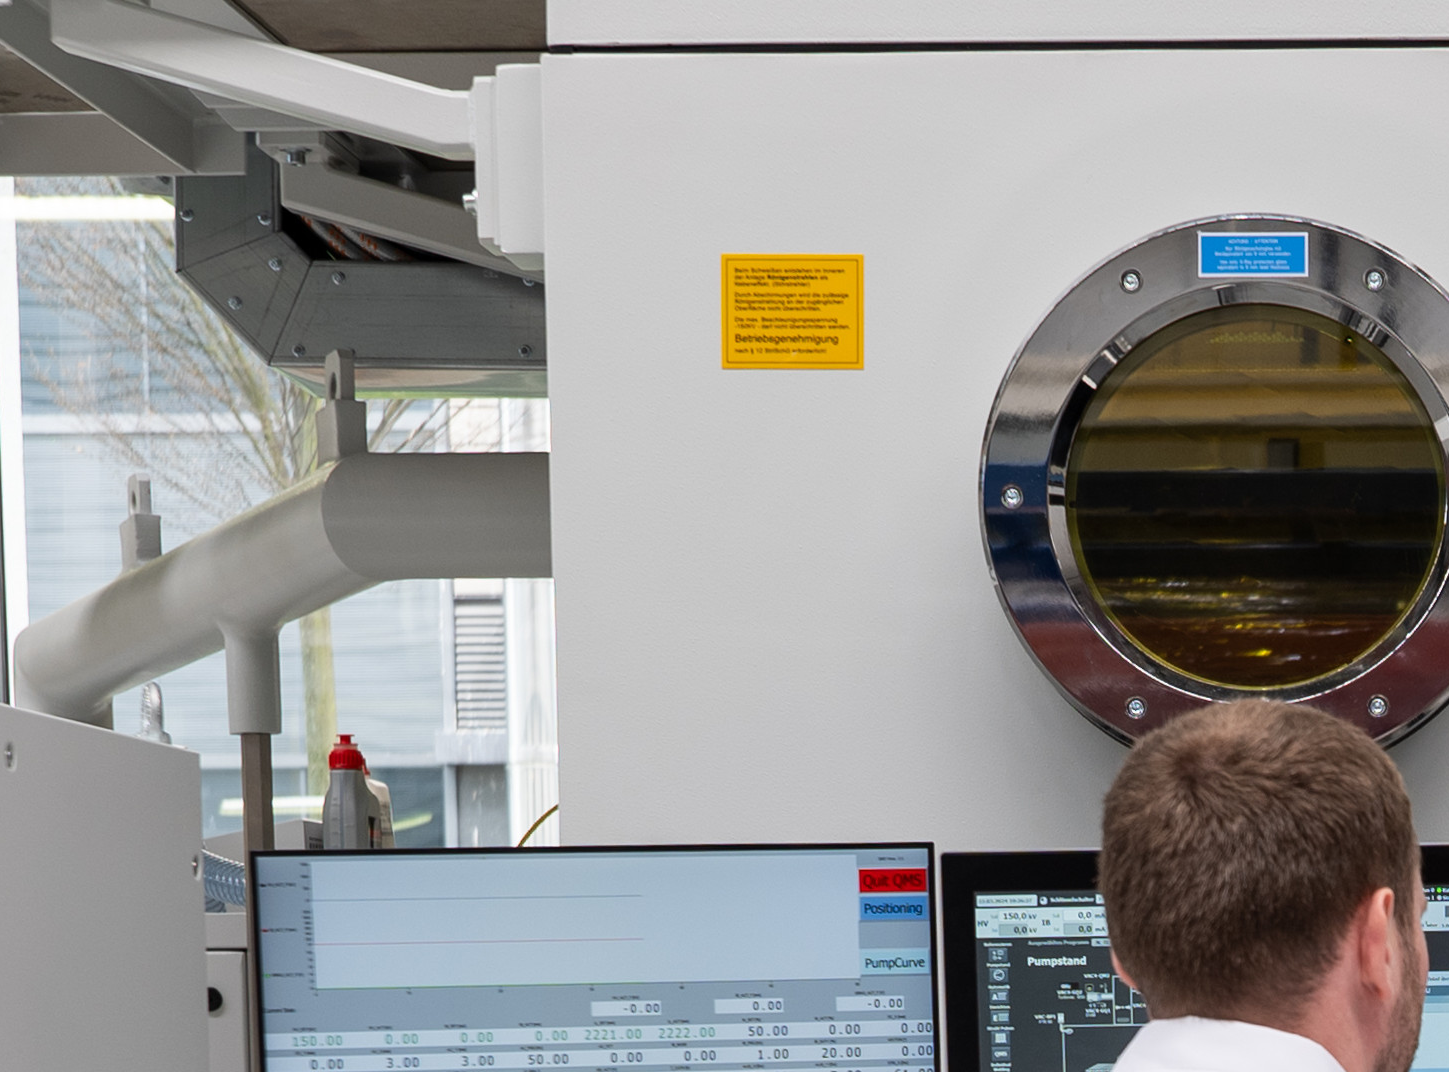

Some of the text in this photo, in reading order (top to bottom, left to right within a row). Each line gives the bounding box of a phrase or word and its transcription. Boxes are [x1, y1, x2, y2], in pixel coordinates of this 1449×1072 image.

[735, 334, 838, 345] Betriebsgenehmigung
[864, 874, 922, 889] Quit QMS
[864, 903, 923, 916] Positioning
[865, 957, 925, 970] PumpCurve
[1027, 956, 1087, 968] Pumpstand
[623, 998, 902, 1014] -0.00 0.00 -0.00
[292, 1023, 932, 1046] 150.00 0.00 0.00 0.00 2221.00 2222.00 50.00 0.00 0.00
[311, 1046, 933, 1070] 0.00 3.00 3.00 50.00 0.00 0.00 1.00 20.00 0.00
